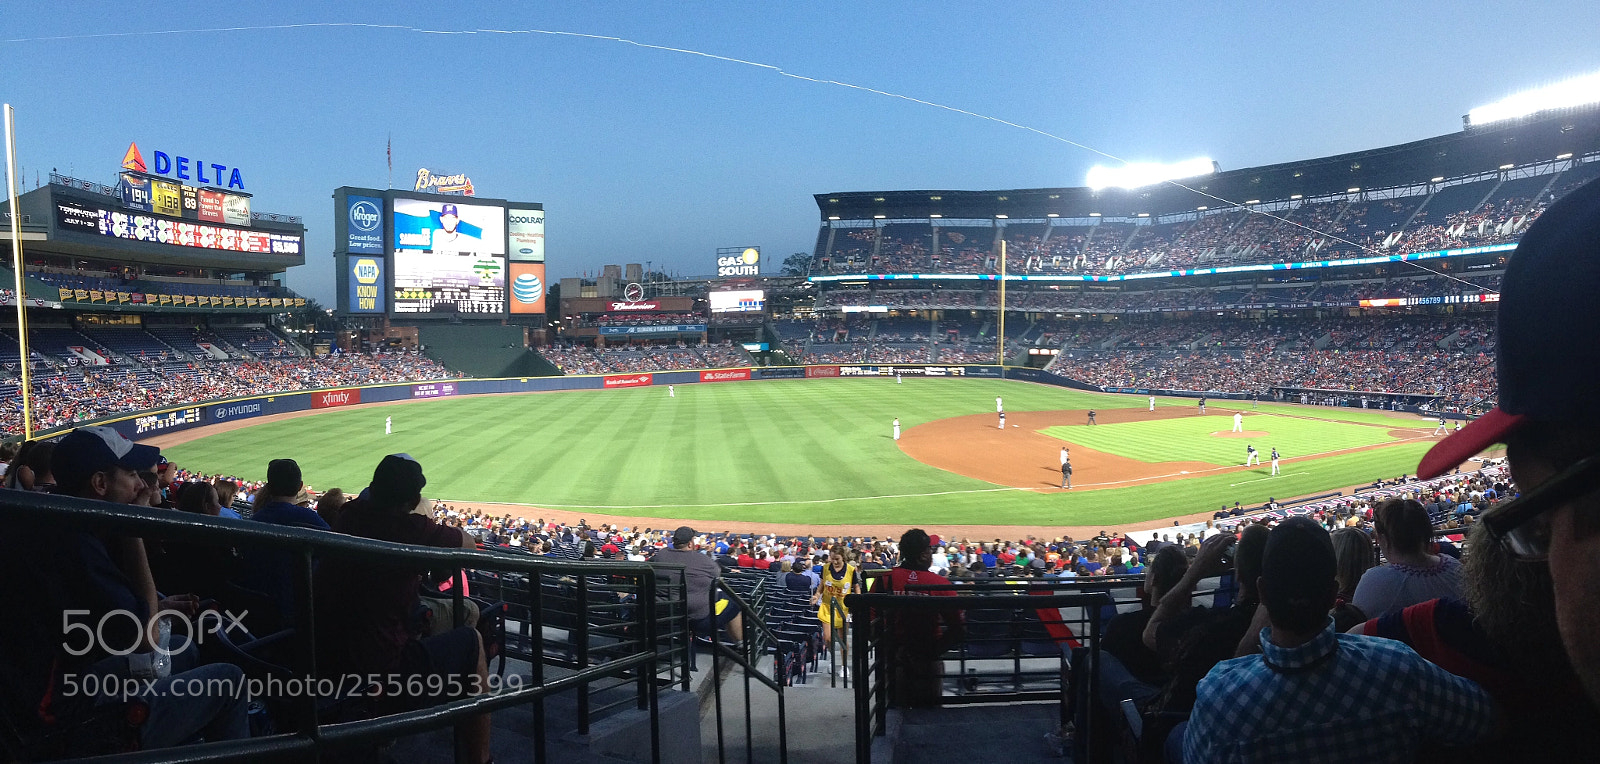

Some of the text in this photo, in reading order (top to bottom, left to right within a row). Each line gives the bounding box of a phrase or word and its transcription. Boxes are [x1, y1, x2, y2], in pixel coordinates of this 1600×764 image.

[154, 150, 244, 190] DELTA
[415, 168, 464, 191] Braves
[132, 188, 148, 204] 194
[164, 195, 178, 210] 138
[184, 197, 197, 210] 89
[354, 206, 378, 227] Kroger
[509, 216, 544, 224] COOLRAY
[718, 256, 743, 266] GAS
[358, 266, 376, 278] NAPA
[718, 266, 758, 276] SOUTH
[357, 286, 378, 298] KNOW
[359, 298, 375, 310] HOW
[611, 302, 656, 310] Budweiser
[322, 392, 349, 405] xfinity
[228, 404, 260, 416] HYUNDAI
